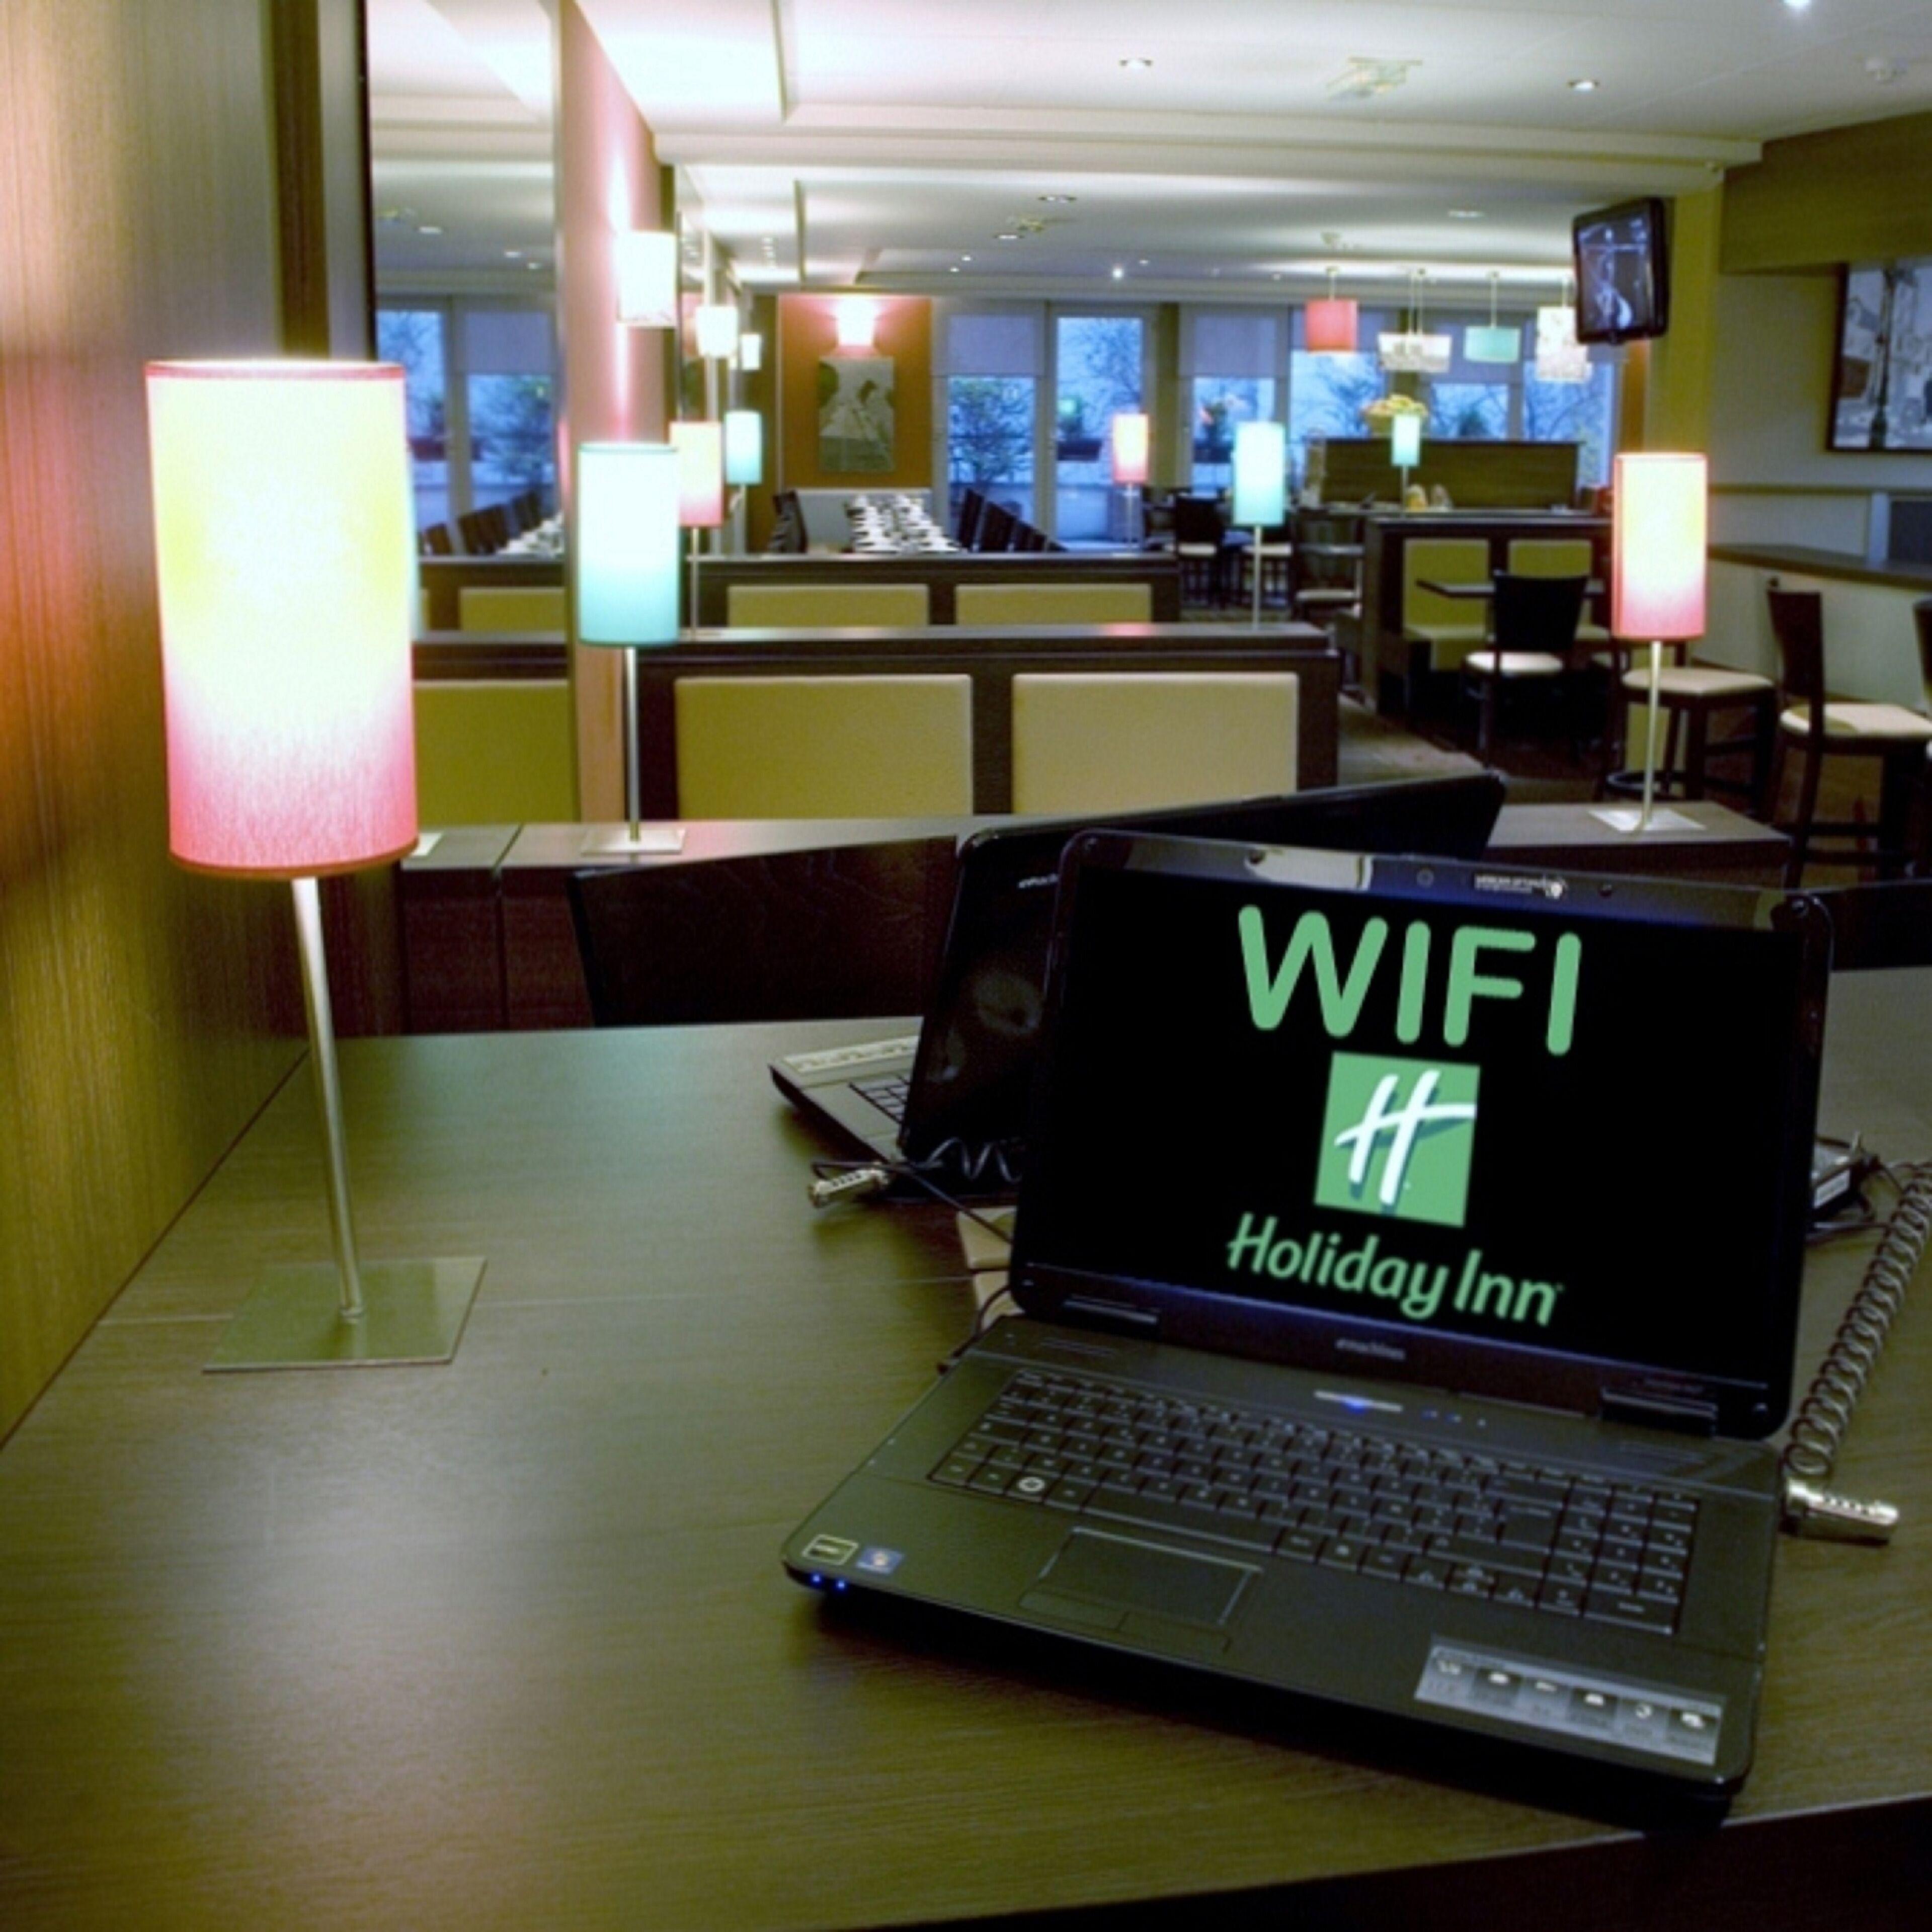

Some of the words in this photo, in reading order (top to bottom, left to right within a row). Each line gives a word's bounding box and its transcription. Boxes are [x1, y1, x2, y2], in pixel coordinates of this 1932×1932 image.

[1238, 905, 1582, 1056] WIFI
[1227, 1213, 1449, 1320] Holiday
[1454, 1249, 1558, 1326] Inn
